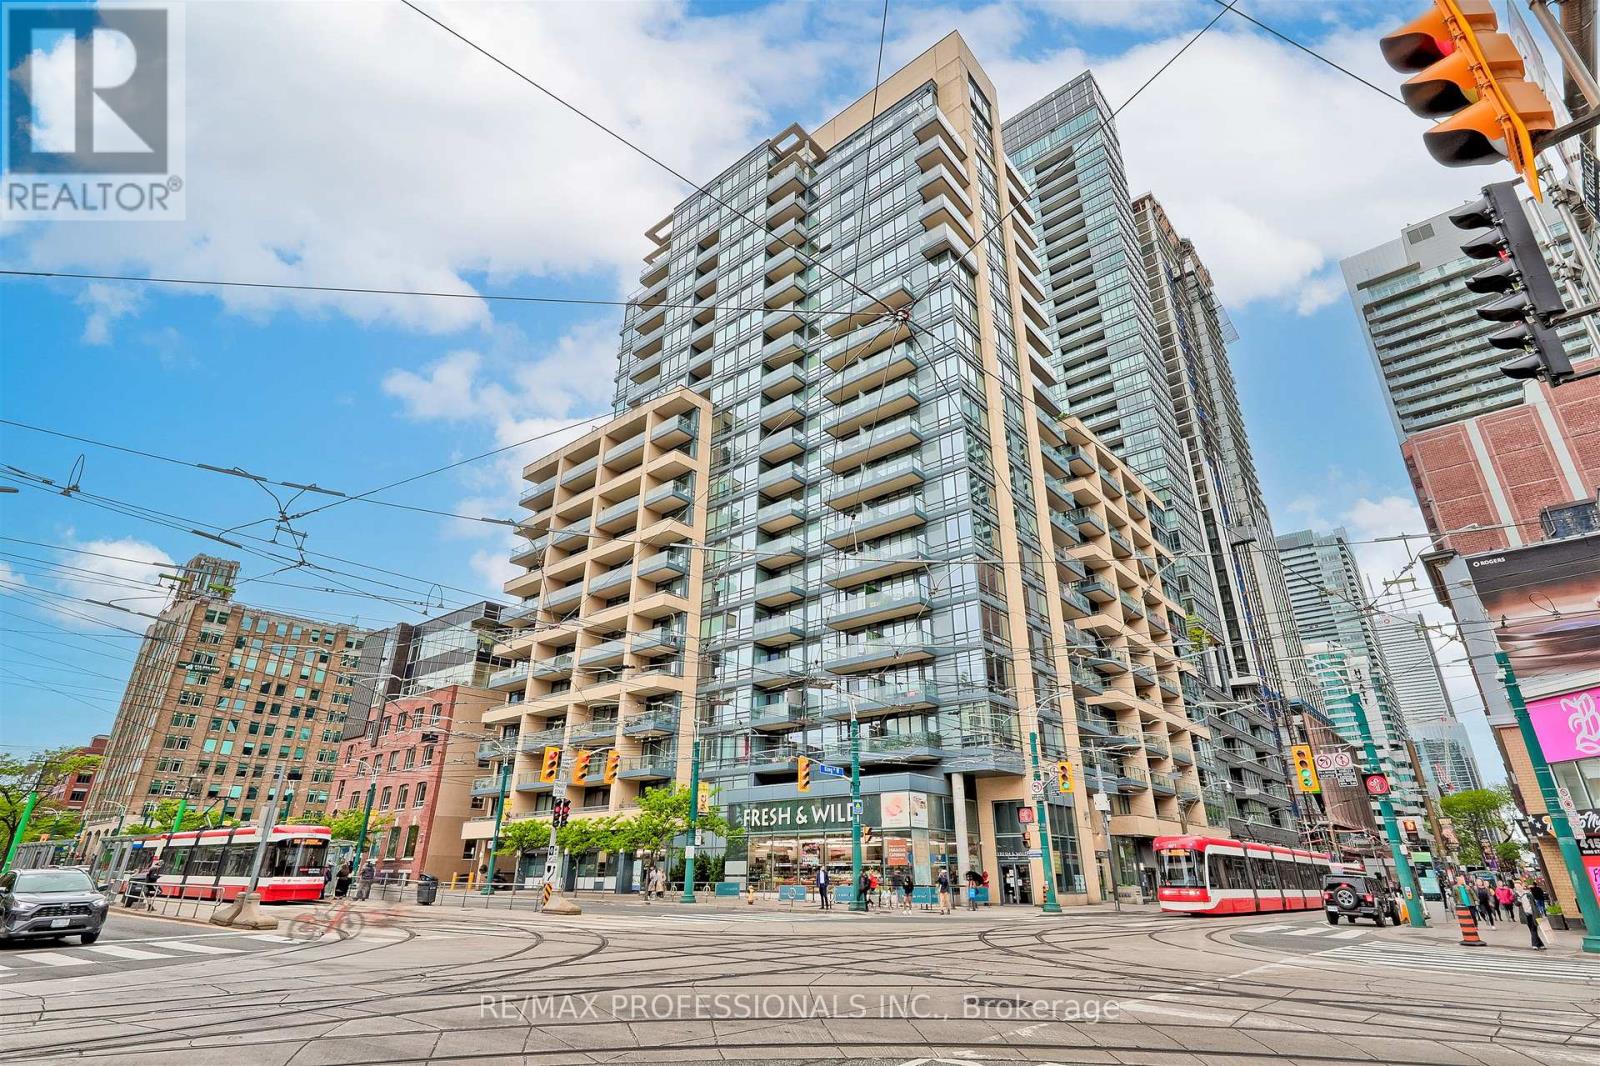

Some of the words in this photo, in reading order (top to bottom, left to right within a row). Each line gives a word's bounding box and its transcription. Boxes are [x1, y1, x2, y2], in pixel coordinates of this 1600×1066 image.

[1583, 147, 1596, 198] VEHICLES
[1480, 557, 1506, 566] ROGERS
[1353, 668, 1369, 705] HYATT
[743, 806, 791, 827] FRESH
[795, 805, 808, 825] &
